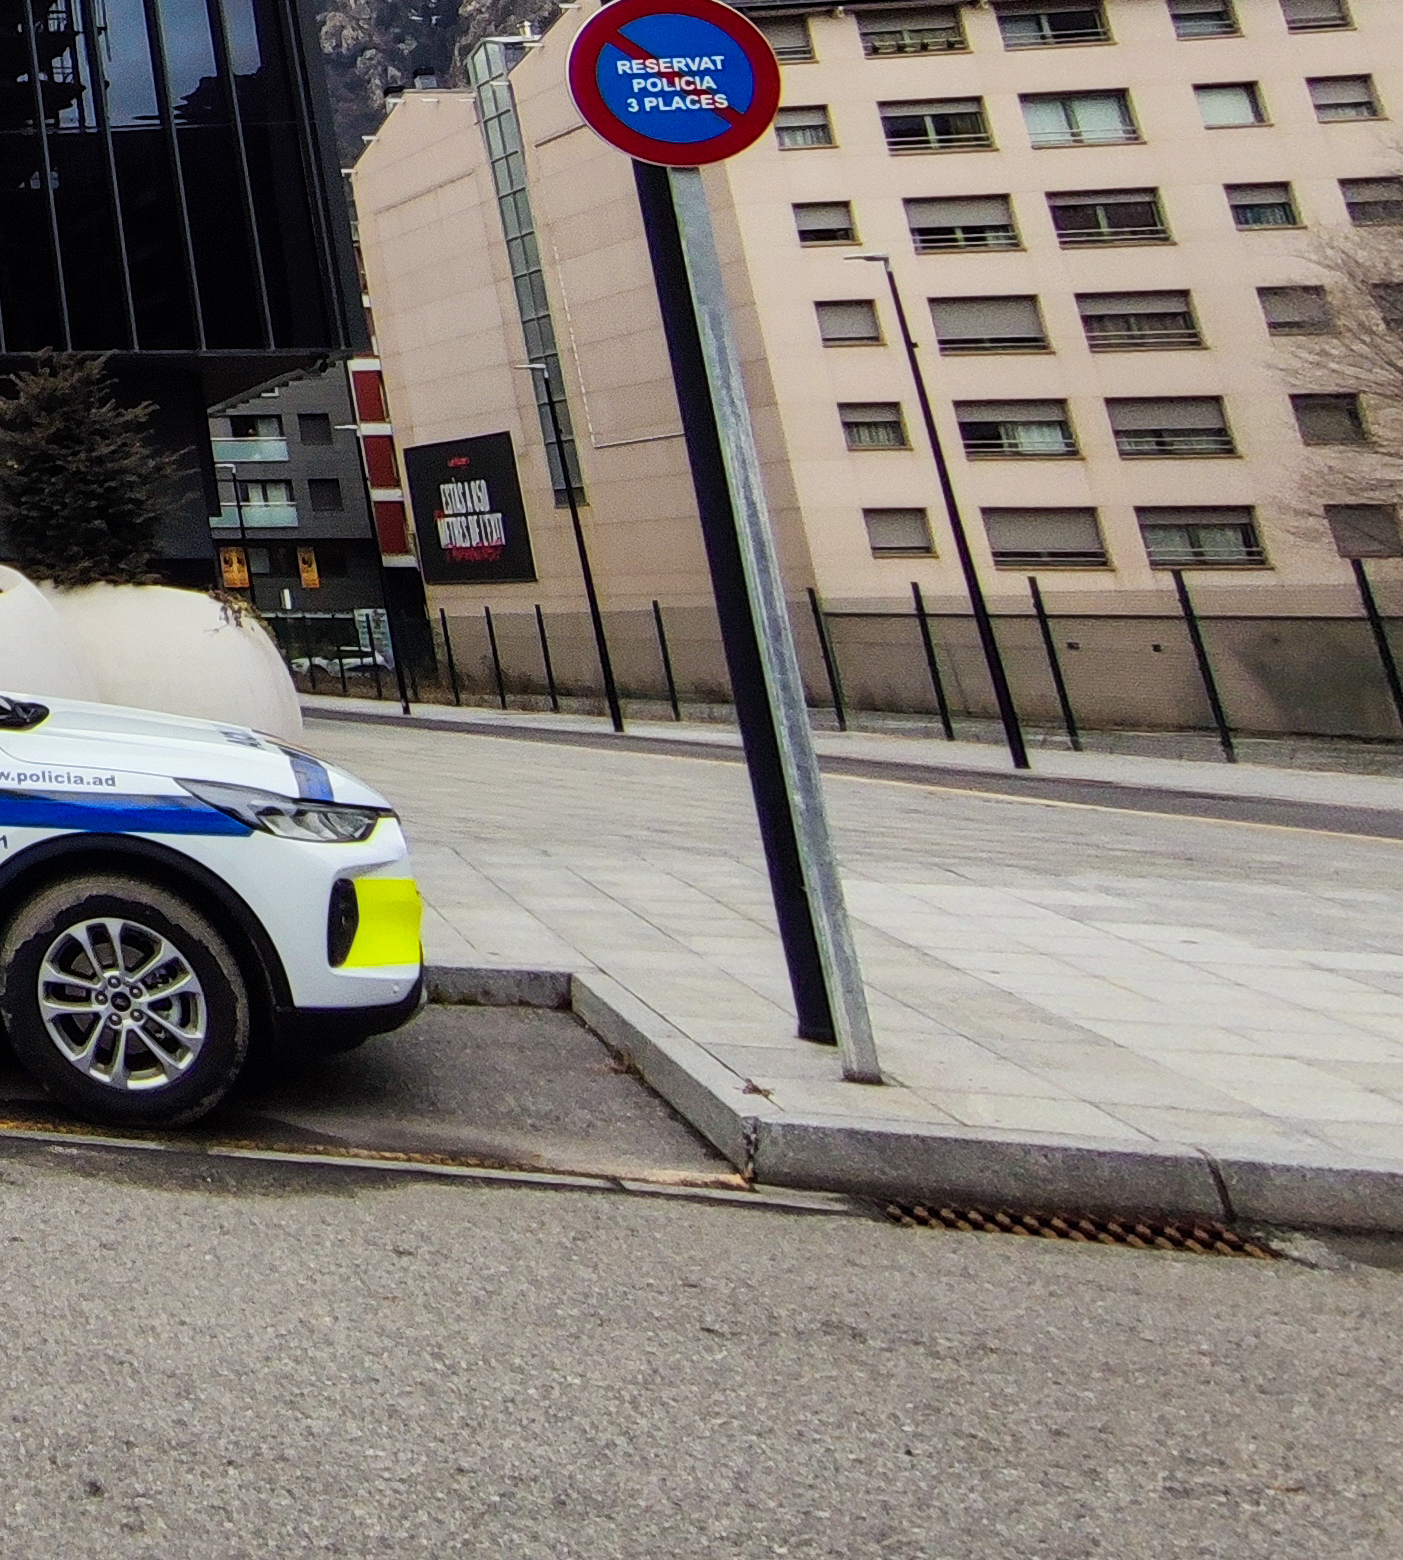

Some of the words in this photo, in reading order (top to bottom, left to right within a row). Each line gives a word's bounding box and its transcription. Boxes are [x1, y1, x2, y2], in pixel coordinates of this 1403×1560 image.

[616, 55, 725, 75] RESERVAT
[632, 75, 718, 93] POLICIA
[626, 97, 640, 113] 3
[643, 93, 729, 112] PLACES
[464, 481, 473, 512] A
